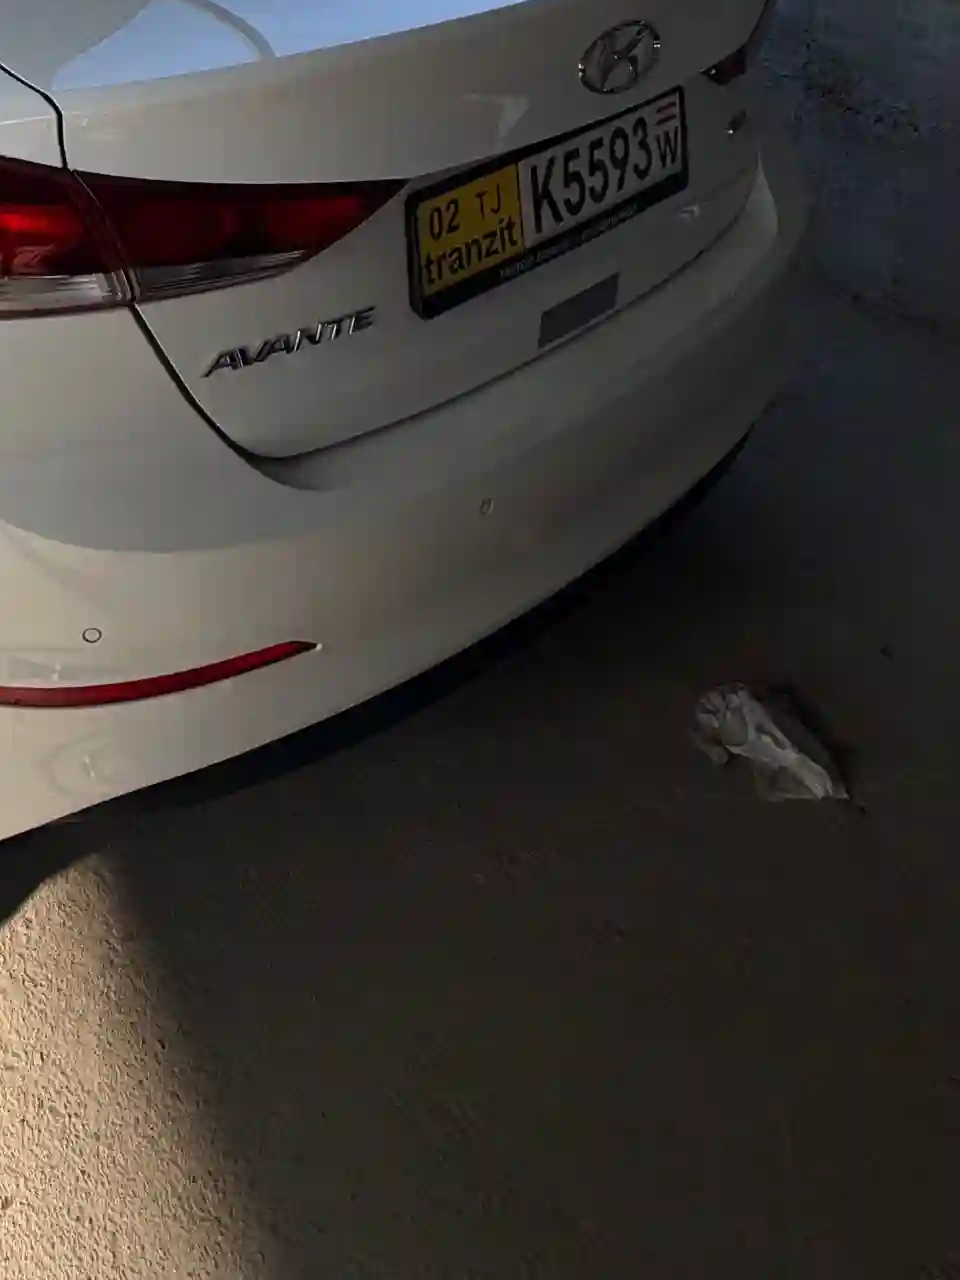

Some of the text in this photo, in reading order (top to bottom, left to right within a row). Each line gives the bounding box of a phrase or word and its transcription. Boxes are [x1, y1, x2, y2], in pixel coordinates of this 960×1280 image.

[428, 198, 461, 241] 02
[476, 183, 502, 220] TJ
[423, 217, 518, 286] tranzit
[201, 305, 377, 379] AVANTE
